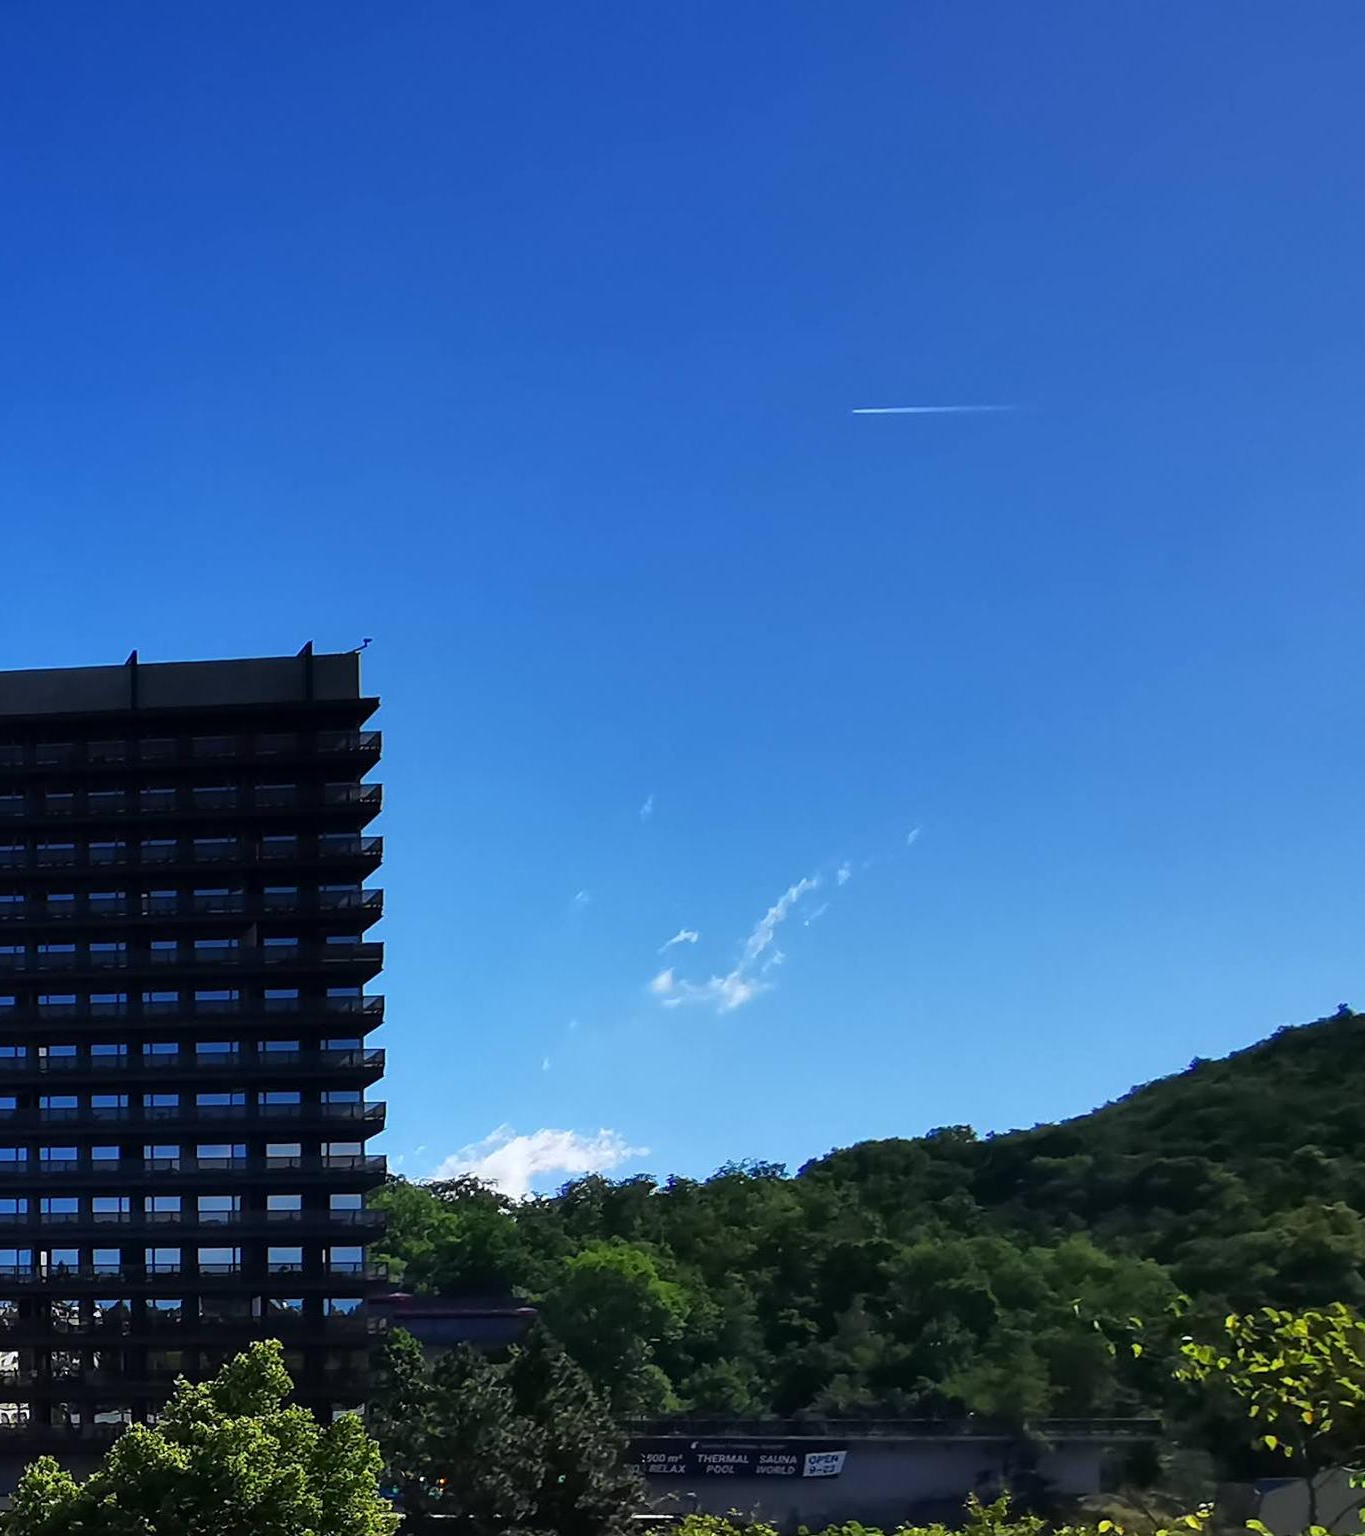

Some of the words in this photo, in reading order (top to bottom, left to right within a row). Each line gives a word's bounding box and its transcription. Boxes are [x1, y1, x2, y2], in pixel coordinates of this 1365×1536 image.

[697, 1453, 749, 1464] THERMAL
[759, 1454, 797, 1465] SAUNA
[808, 1455, 839, 1465] OPEN
[649, 1464, 686, 1473] RELAX
[706, 1464, 736, 1474] POOL
[756, 1465, 796, 1475] WORLD
